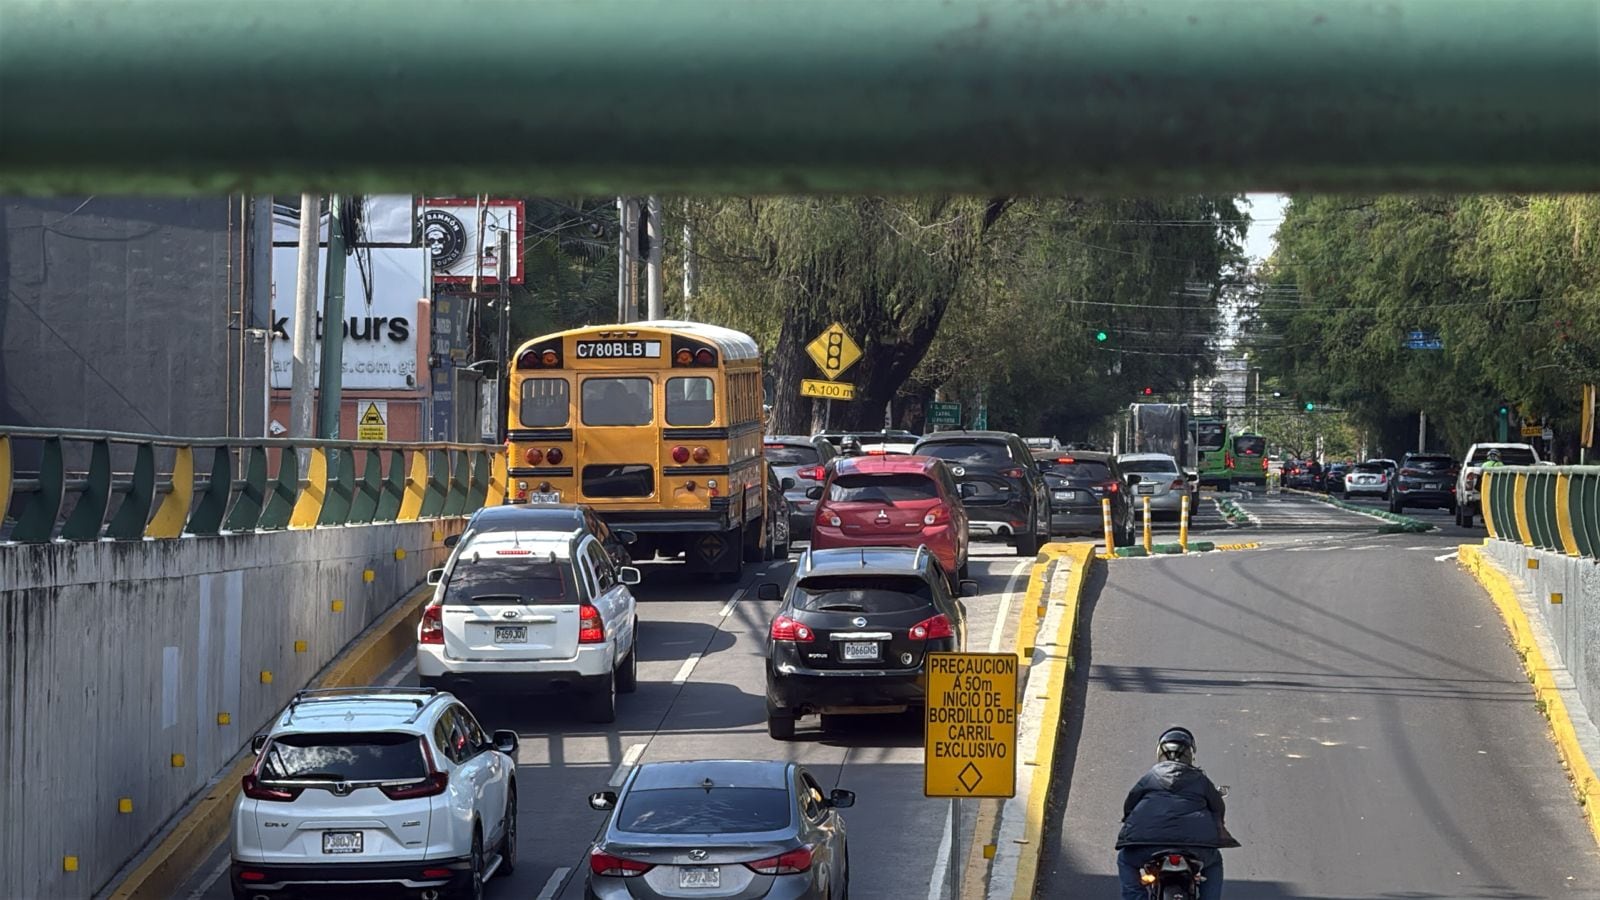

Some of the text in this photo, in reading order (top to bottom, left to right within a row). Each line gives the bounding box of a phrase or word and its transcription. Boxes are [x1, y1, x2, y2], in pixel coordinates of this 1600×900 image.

[316, 311, 409, 342] turs
[578, 343, 642, 356] C780BLB
[808, 384, 817, 394] A
[820, 386, 839, 396] 100
[932, 658, 1014, 674] PRECAUCION
[966, 676, 992, 691] 50m
[944, 692, 1000, 707] INICIO DE
[930, 708, 1013, 723] BORDILLO DE
[948, 725, 994, 740] CARRIL
[936, 742, 1006, 758] EXCLUSIVO
